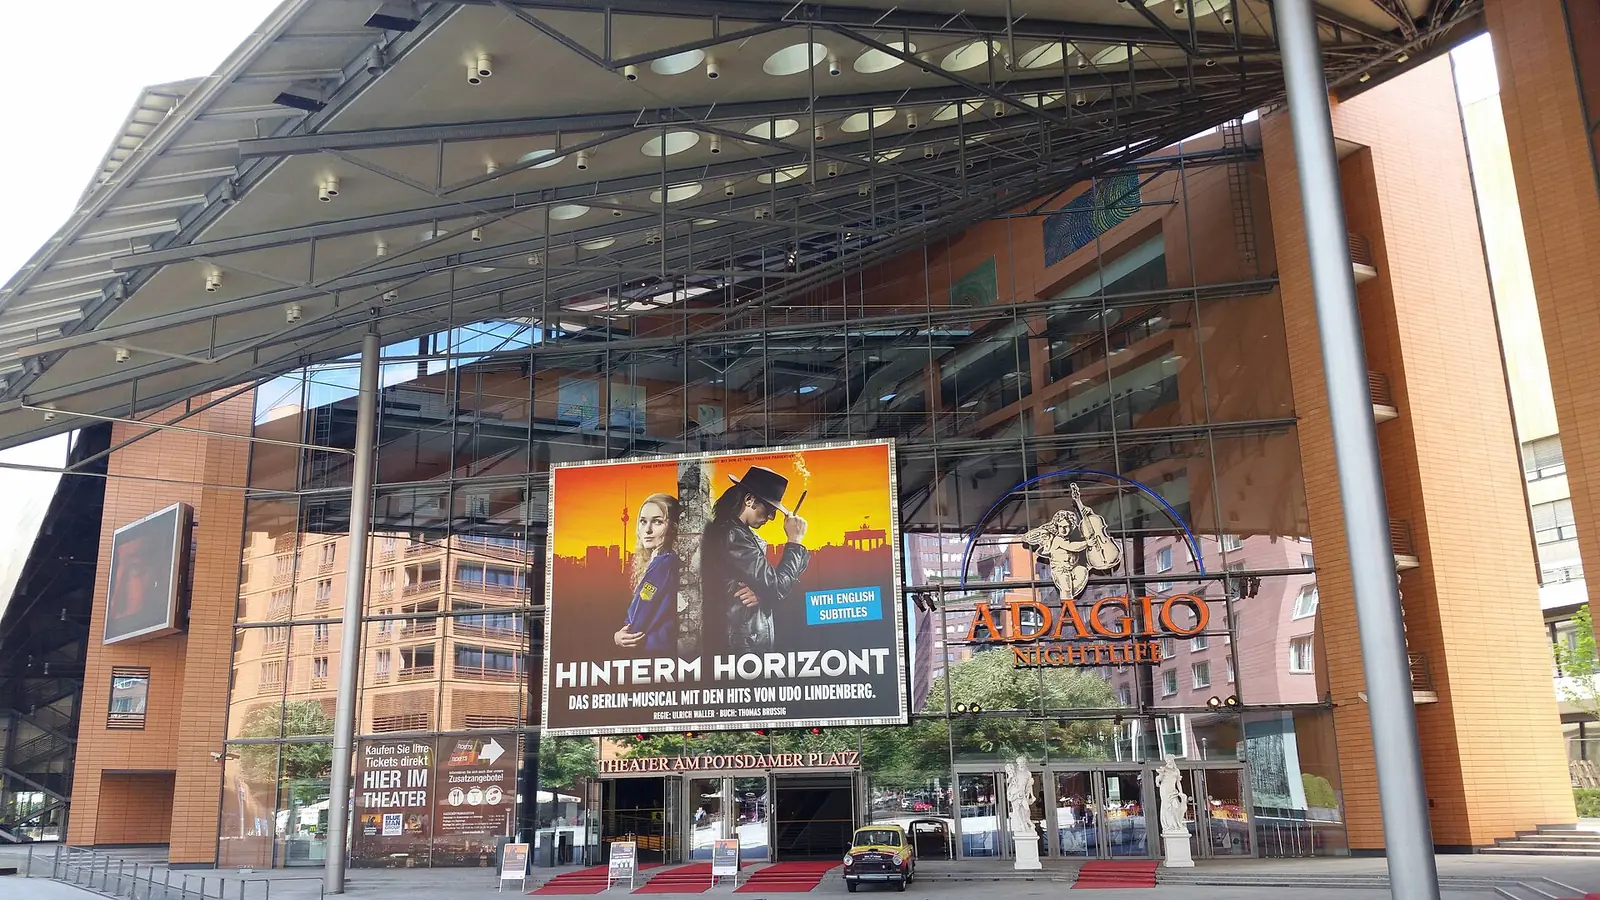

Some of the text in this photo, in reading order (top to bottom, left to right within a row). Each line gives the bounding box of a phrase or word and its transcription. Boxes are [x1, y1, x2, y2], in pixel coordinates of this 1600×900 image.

[810, 591, 874, 606] WITH ENGLISH
[820, 606, 868, 620] SUBTITLES
[963, 593, 1210, 640] ADAGIO
[1013, 642, 1163, 667] NIGHTLIFE
[555, 648, 890, 688] HINTERM HORIZONT
[569, 683, 876, 710] DAS BERLIN-MUSICAL MIT DEN HITS VON UDO LINDENBERG.
[654, 708, 786, 720] REGIE: ULRICH WALLER BUCH: THOMAS BRUSSIG
[366, 744, 428, 755] Kaufen Sie Ihre
[366, 756, 428, 767] Tickets direkt
[598, 752, 860, 773] THEATER AM POTSDAMER PLATZ
[364, 769, 428, 788] HIER IM
[449, 774, 504, 783] Zusatzangebote!
[364, 791, 426, 808] THEATER
